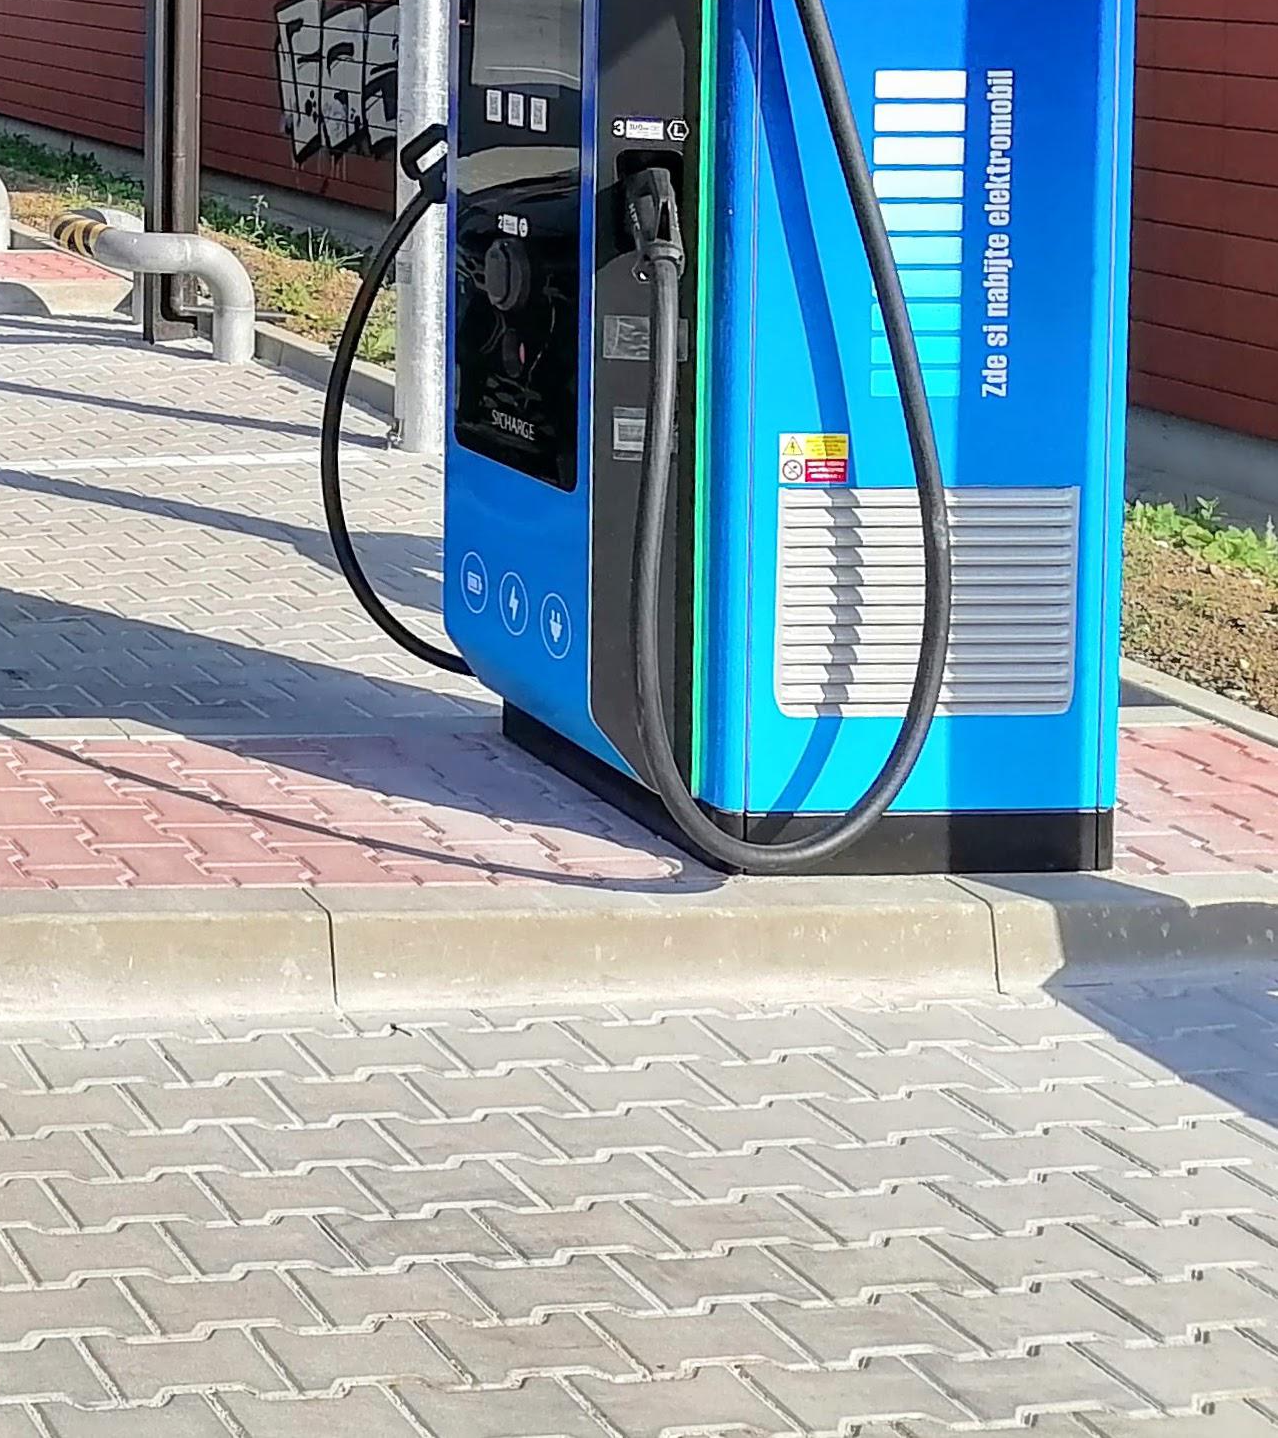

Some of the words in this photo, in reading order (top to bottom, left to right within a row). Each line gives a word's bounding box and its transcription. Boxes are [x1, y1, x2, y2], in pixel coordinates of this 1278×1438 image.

[612, 120, 625, 136] 3
[983, 69, 1014, 227] elektromobil
[982, 324, 1008, 347] si
[982, 353, 1008, 398] Zde
